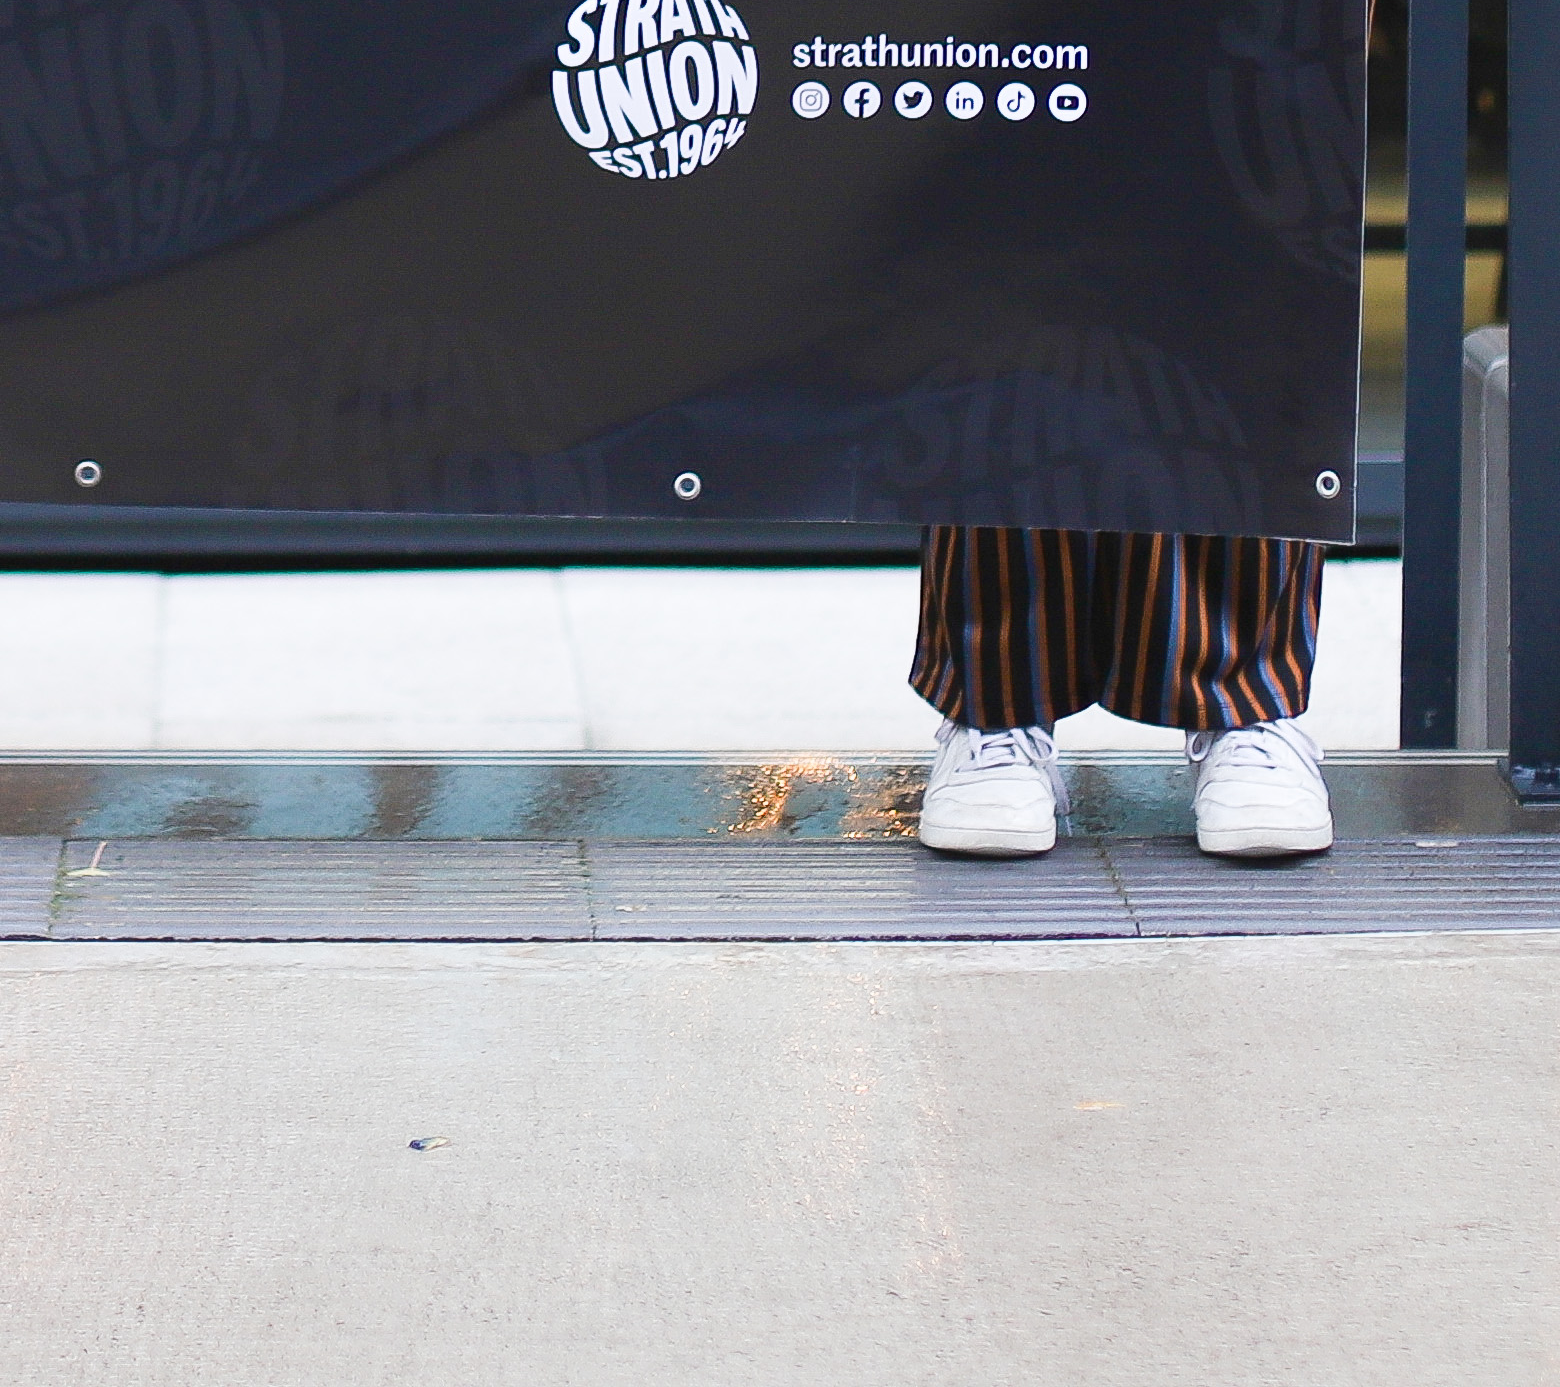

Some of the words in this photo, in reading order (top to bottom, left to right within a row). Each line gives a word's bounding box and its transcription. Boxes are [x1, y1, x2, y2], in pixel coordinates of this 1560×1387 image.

[792, 33, 1088, 70] strathunion.com
[552, 40, 758, 149] UNION
[588, 117, 747, 180] EST.1964
